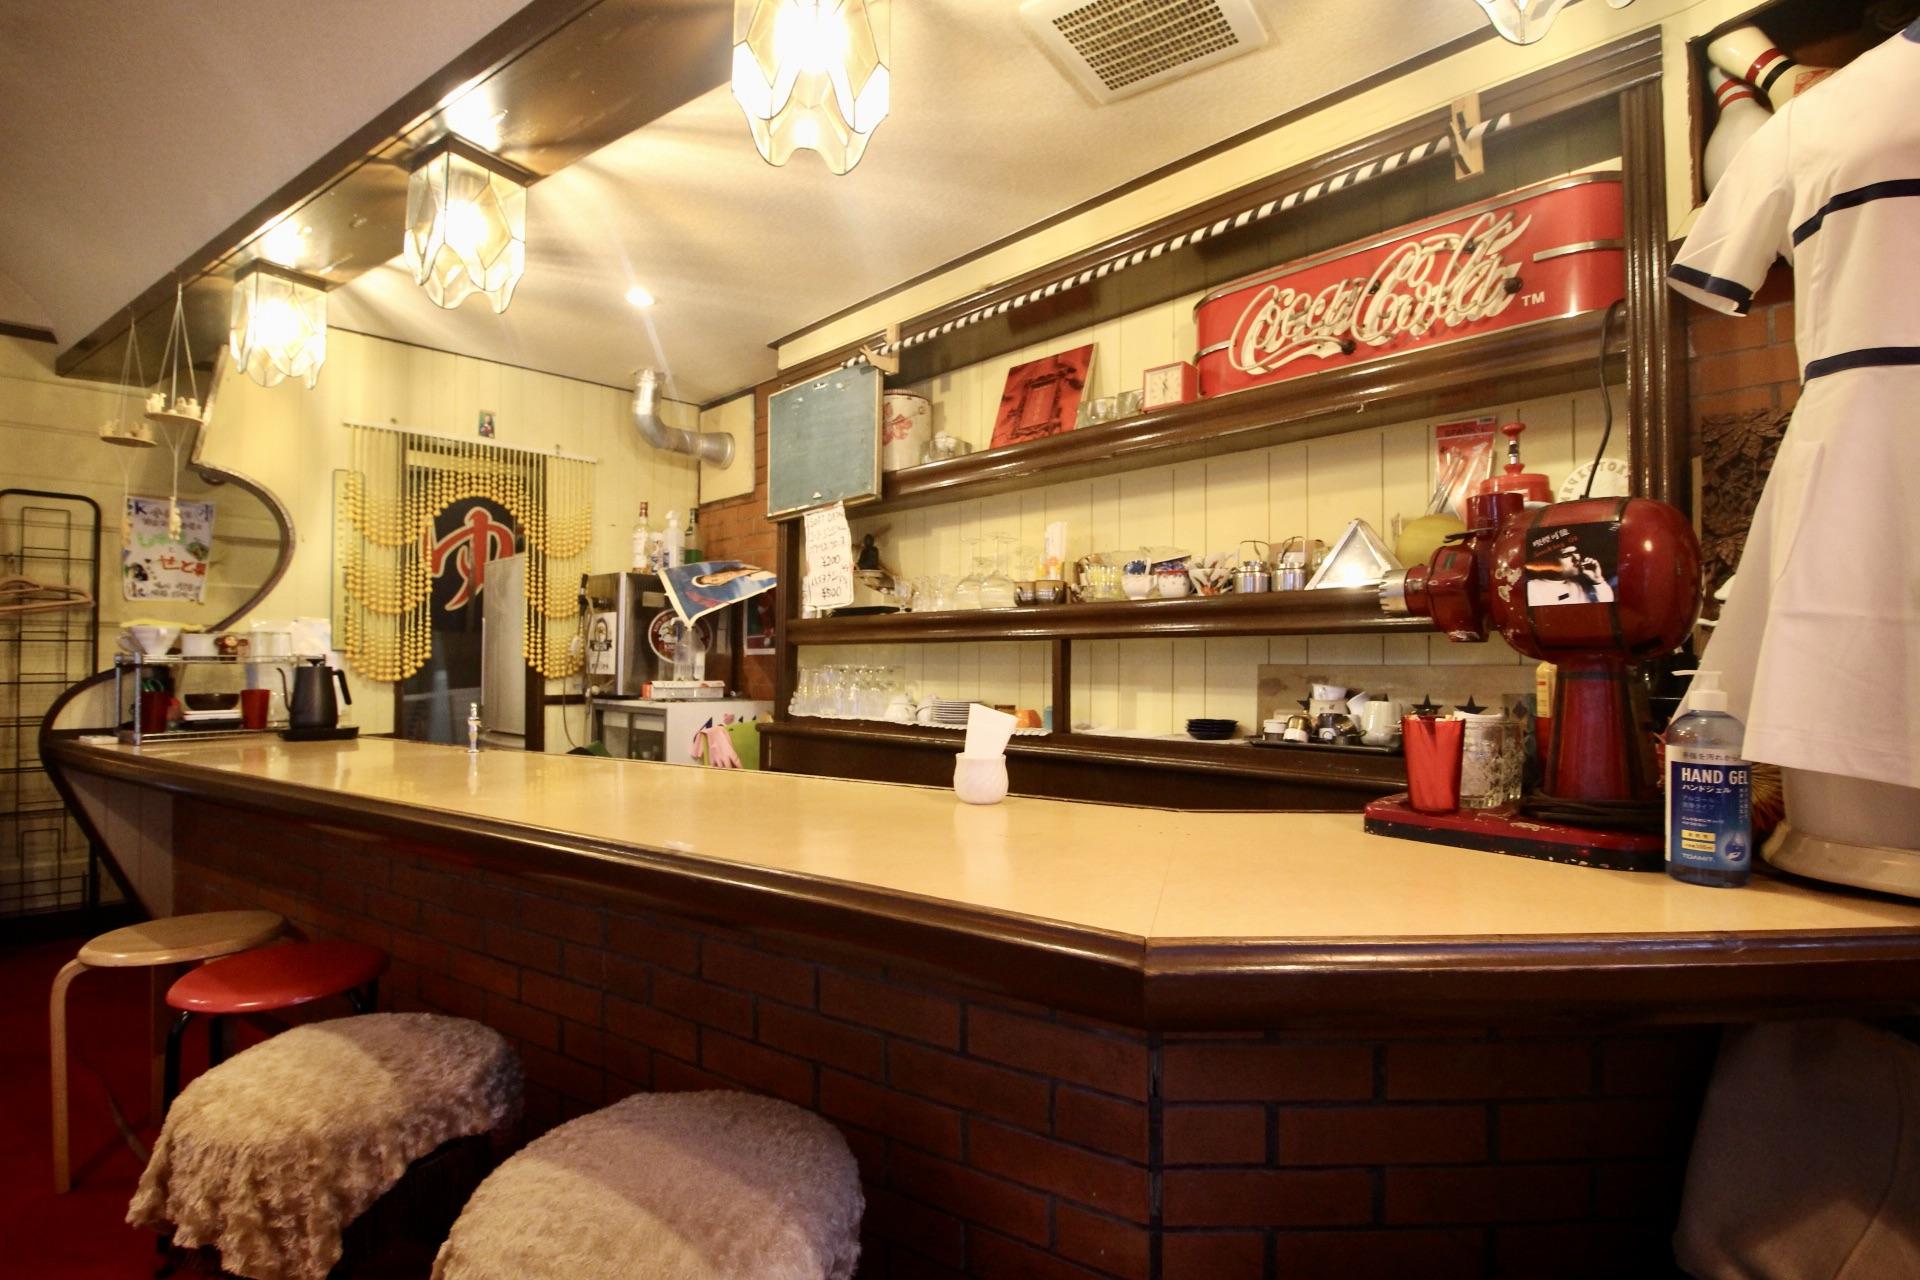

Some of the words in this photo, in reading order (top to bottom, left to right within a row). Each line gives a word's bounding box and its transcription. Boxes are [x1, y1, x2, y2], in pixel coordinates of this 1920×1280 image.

[1681, 767, 1724, 784] HAND
[1728, 770, 1748, 785] GEL
[1681, 784, 1732, 794] ハンドジェル
